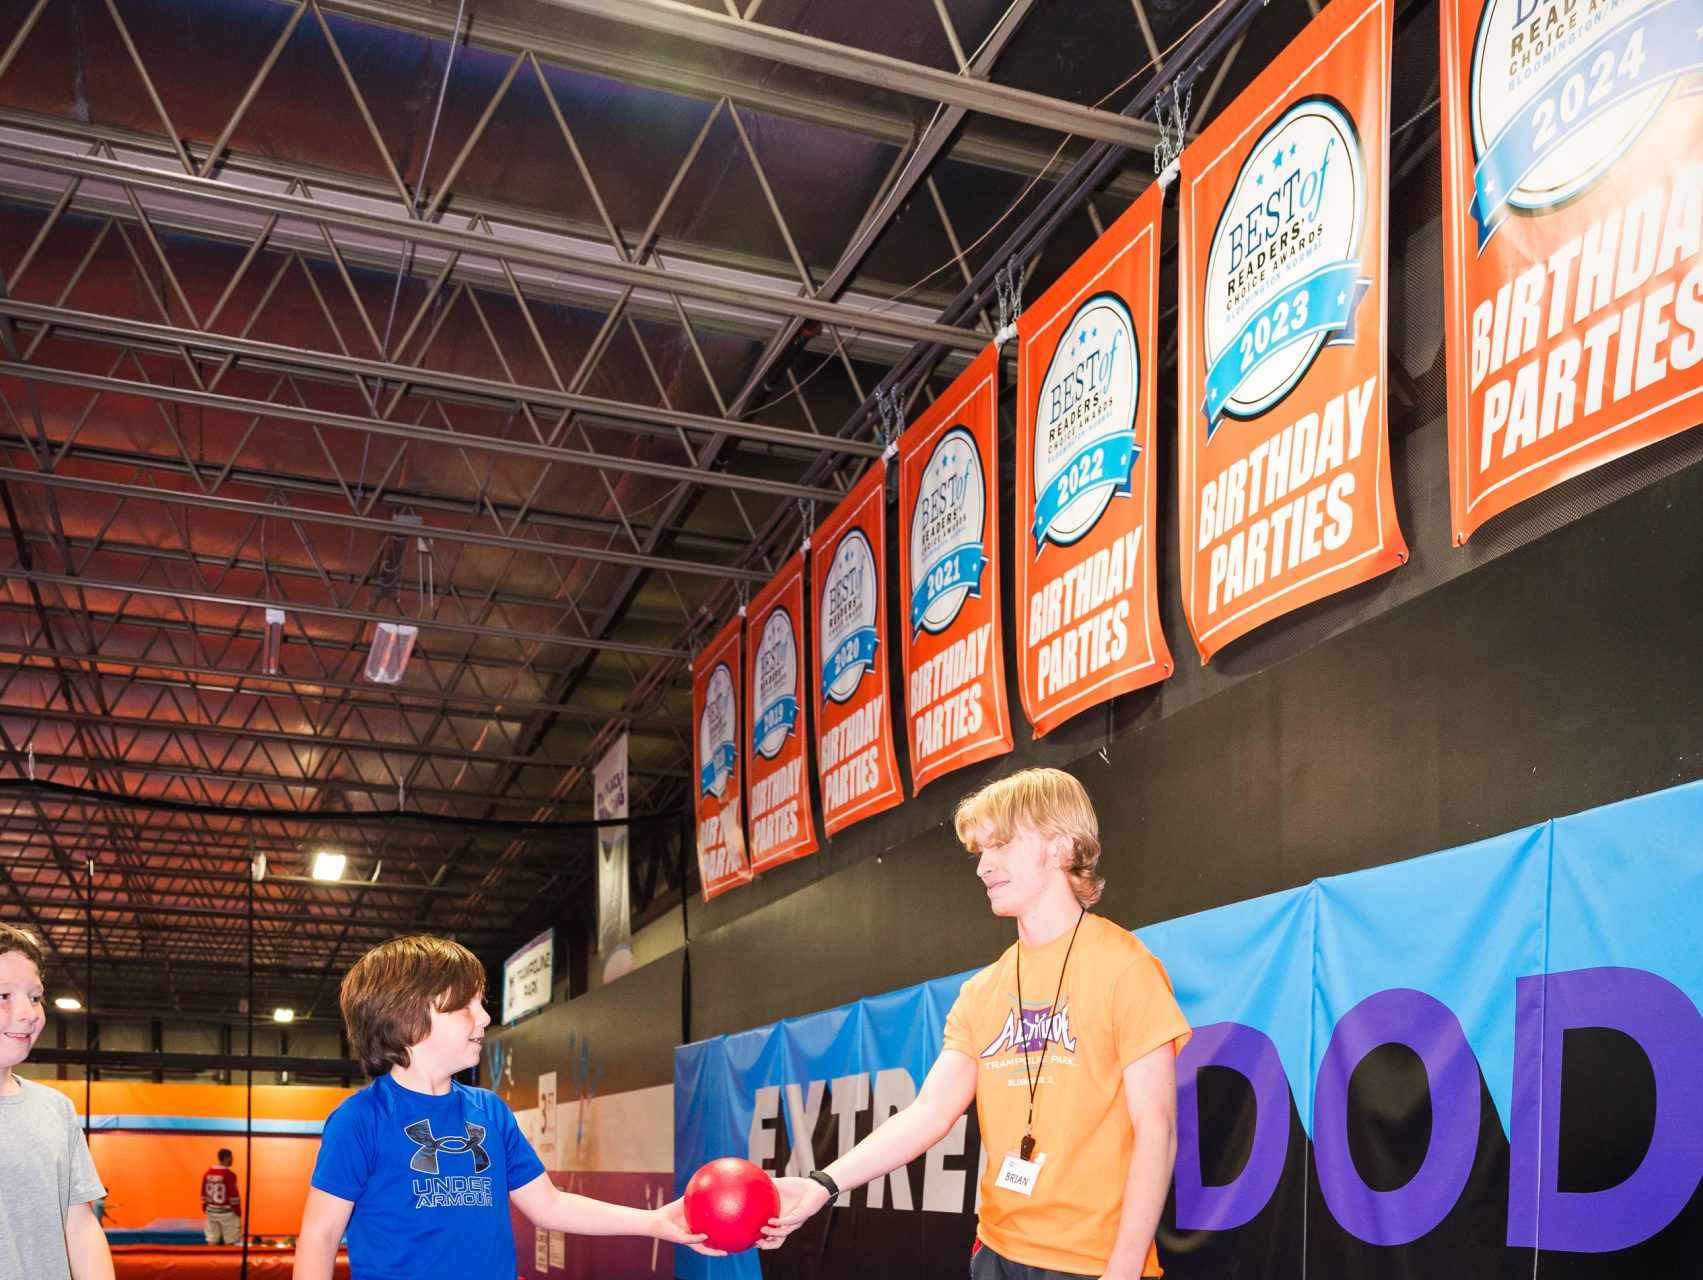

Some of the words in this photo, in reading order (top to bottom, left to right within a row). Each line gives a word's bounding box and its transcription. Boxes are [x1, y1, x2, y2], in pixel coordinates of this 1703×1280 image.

[1509, 12, 1577, 76] CHOICE
[1532, 27, 1646, 153] 2024
[1228, 168, 1301, 276] BEST
[1299, 138, 1335, 223] of
[1226, 268, 1267, 311] CHOICE
[1272, 223, 1323, 277] AWARDS
[1227, 217, 1305, 298] READERS'
[1239, 290, 1311, 374] 2023
[1480, 264, 1703, 474] PARTIES
[1049, 349, 1100, 426] BEST
[1098, 328, 1123, 395] of
[1047, 428, 1076, 454] CHOICE
[1057, 448, 1105, 508] 2022
[1198, 375, 1378, 553] BIRTHDAY
[921, 473, 957, 532] BEST
[927, 555, 961, 601] 2021
[1207, 472, 1356, 616] PARTIES
[1028, 524, 1143, 649] BIRTHDAY
[834, 637, 860, 676] 2020
[910, 622, 991, 719] BIRTHDAY
[1037, 599, 1130, 702] PARTIES
[820, 693, 883, 776] BIRTHDAY
[916, 682, 983, 763] PARTIES
[751, 756, 802, 821] BIRTHDAY
[825, 745, 879, 816] PARTIES
[754, 799, 799, 858] PARTIES
[980, 1003, 1077, 1059] ALTITUDE
[412, 1176, 492, 1197] UNDER
[415, 1192, 493, 1209] ARMOUR
[1005, 1172, 1029, 1187] BRIAN
